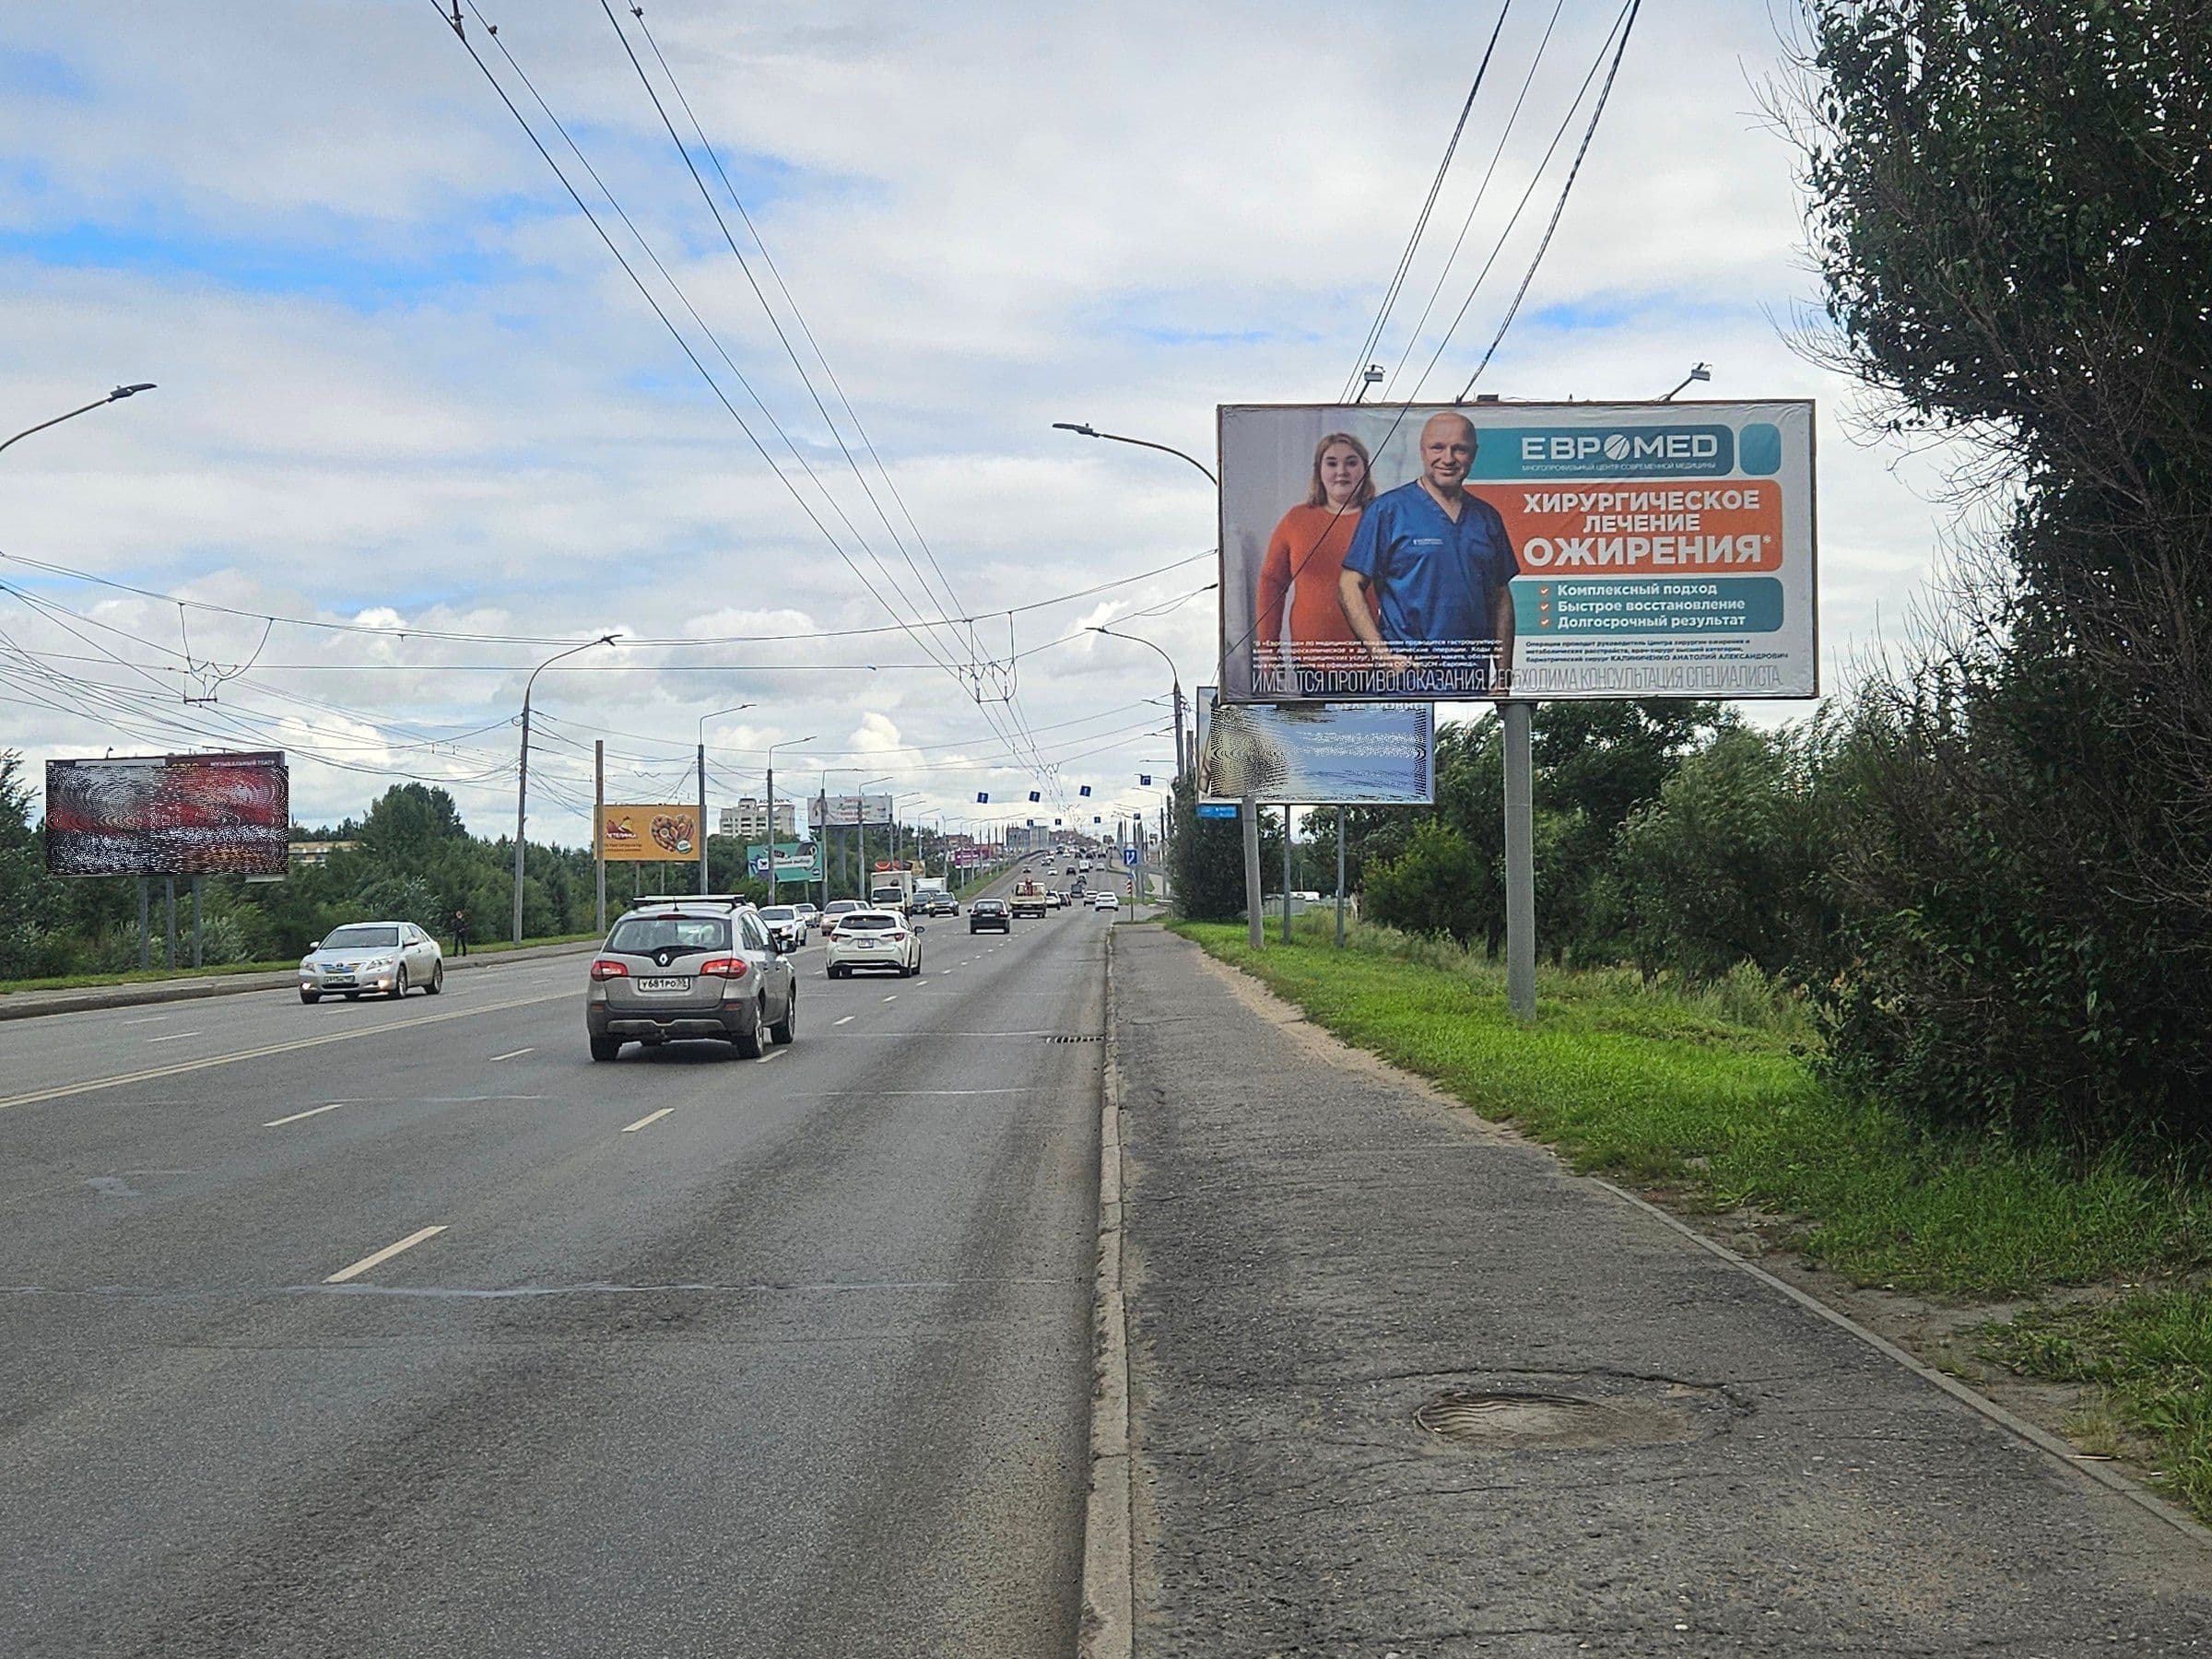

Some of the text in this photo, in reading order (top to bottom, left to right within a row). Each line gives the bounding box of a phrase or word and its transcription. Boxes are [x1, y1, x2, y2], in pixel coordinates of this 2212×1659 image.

[1523, 489, 1760, 513] ХИРУРГИЧЕСКОЕ
[1583, 513, 1700, 534] ЛЕЧЕНИЕ
[1557, 583, 1717, 597] Комплексный подход
[1557, 599, 1746, 615] Быстрое восстановление
[1557, 615, 1746, 629] Долгосрочный результат
[1253, 670, 1324, 692] ИМЕЮТСЯ
[1581, 666, 1683, 690] КОНСУЛЬТАЦИЯ
